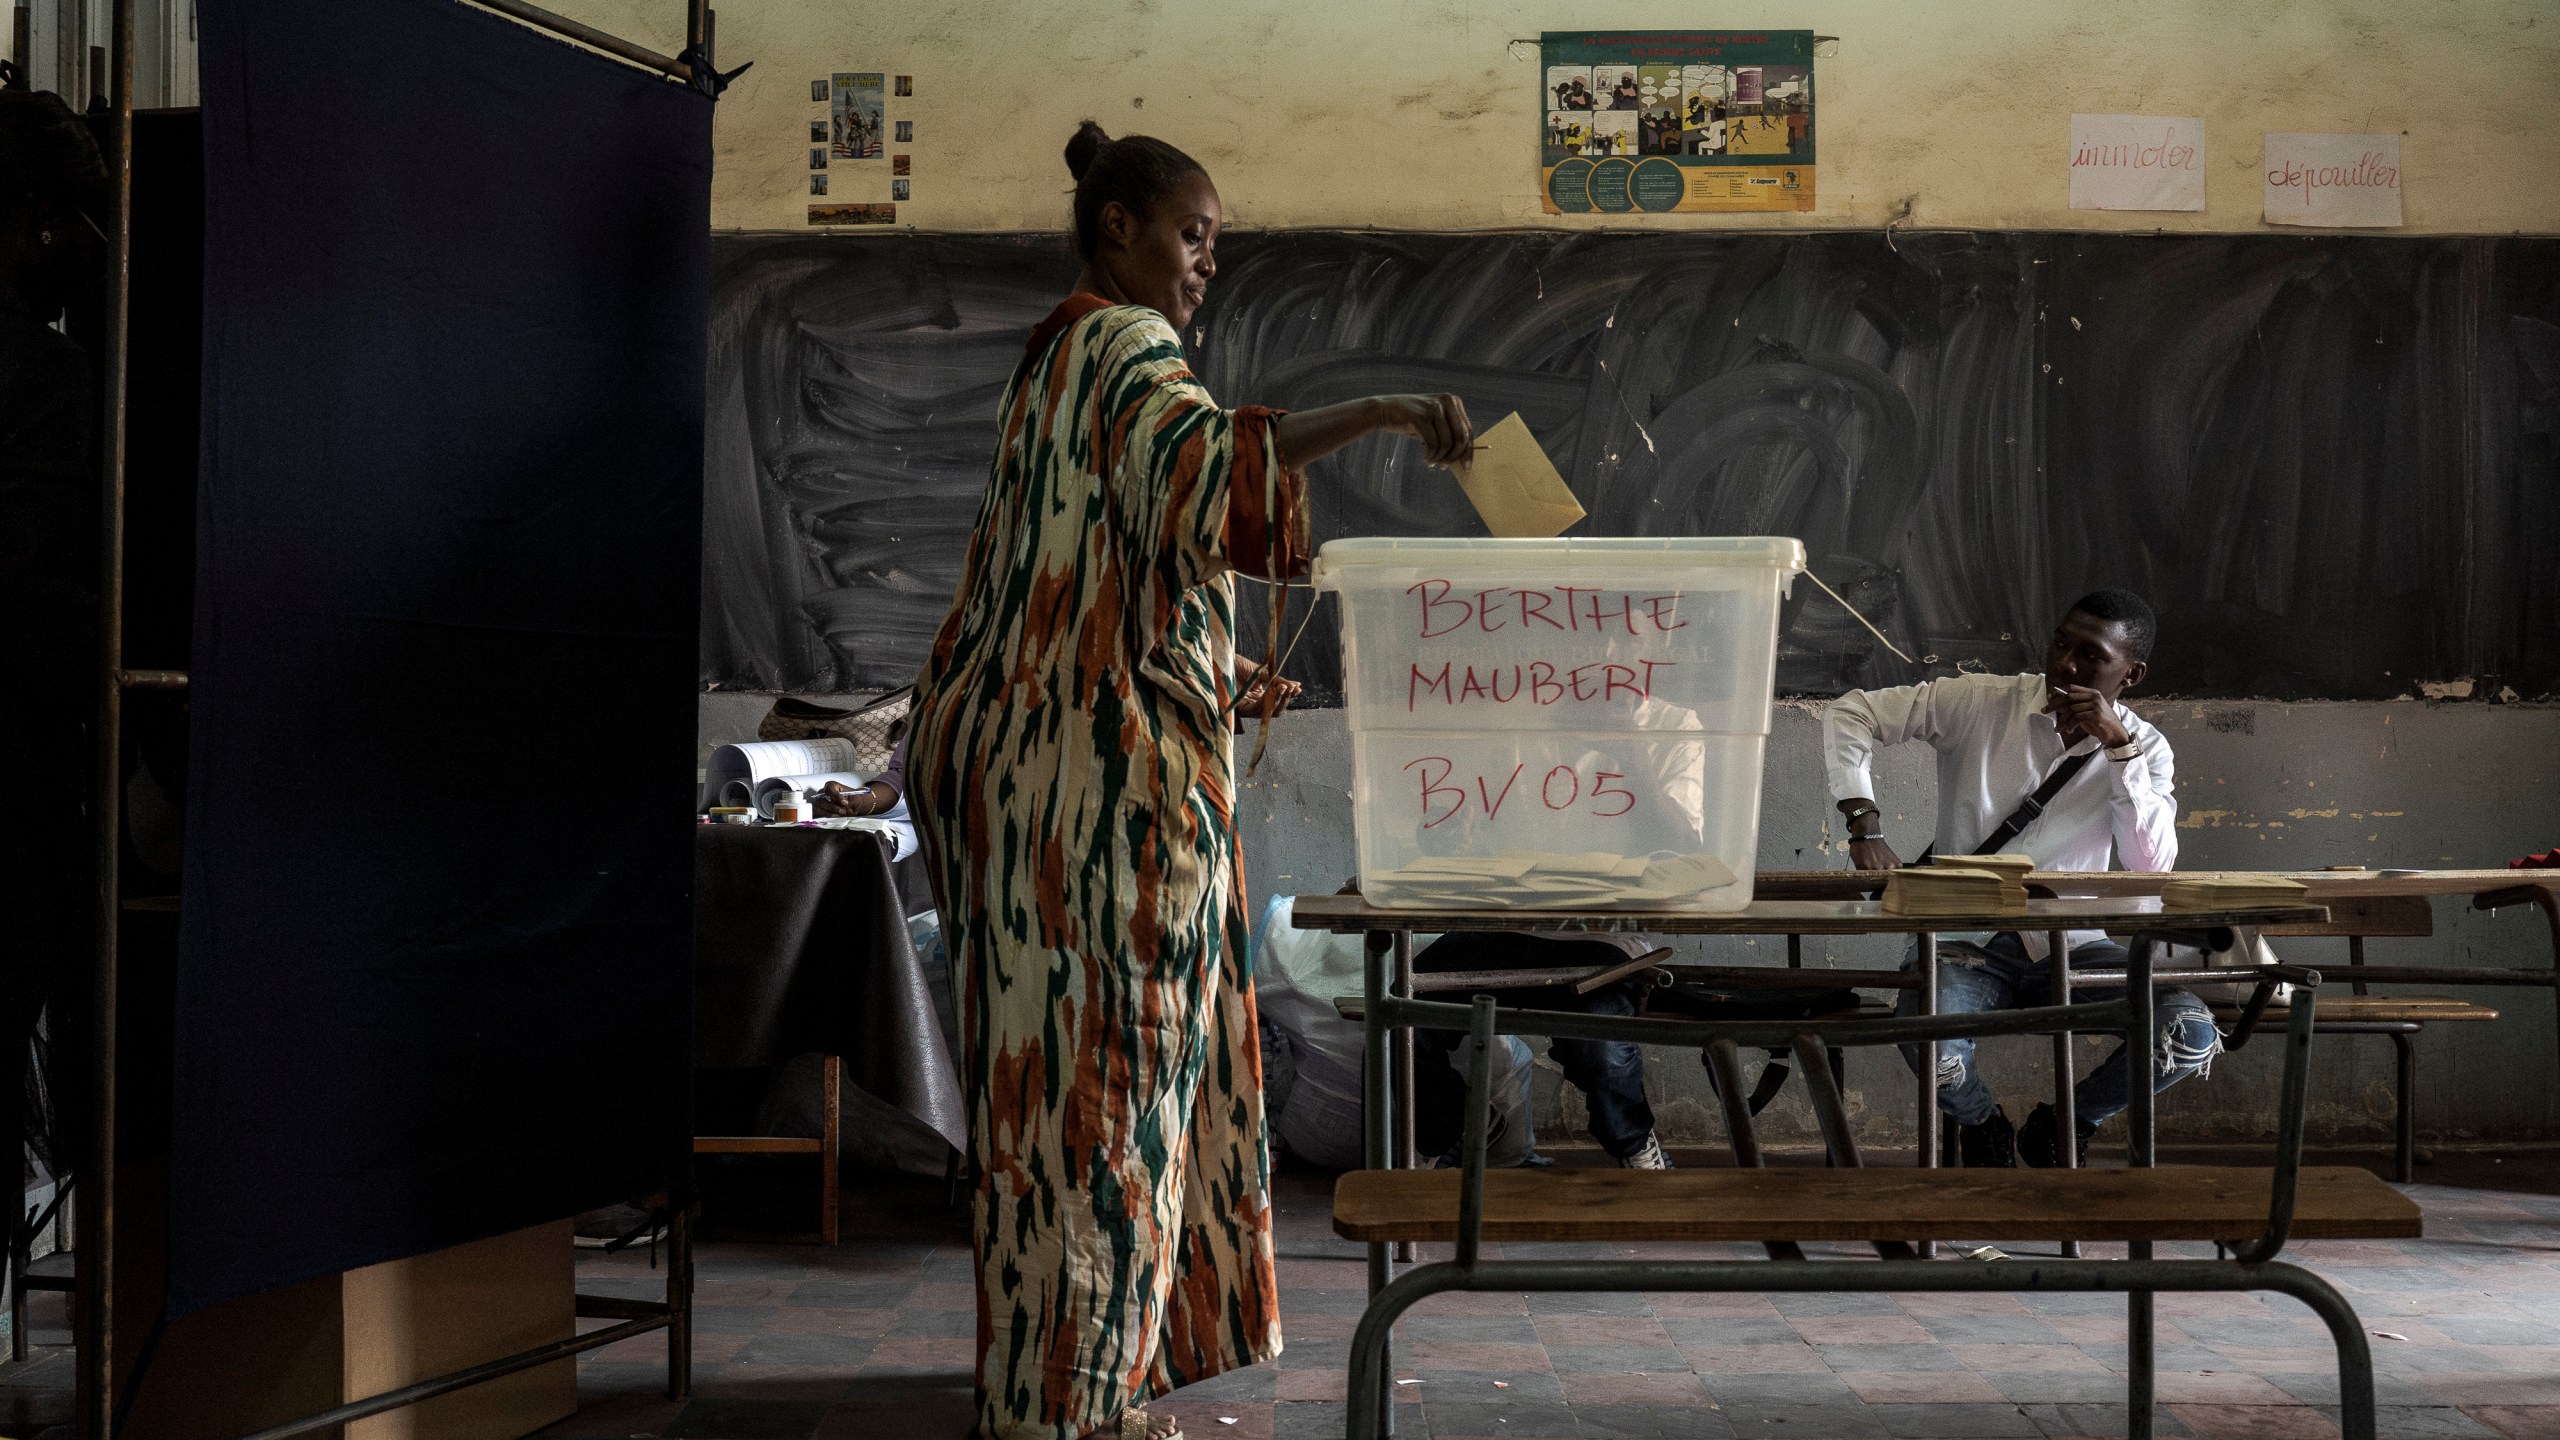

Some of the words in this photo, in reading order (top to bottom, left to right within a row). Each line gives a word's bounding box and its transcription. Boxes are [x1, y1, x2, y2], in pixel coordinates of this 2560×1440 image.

[2267, 152, 2400, 207] dépouiller
[1406, 578, 1691, 639] BERTHE
[1407, 659, 1677, 713] MAUBERT
[1404, 756, 1524, 830] BV
[1542, 765, 1636, 817] 05
